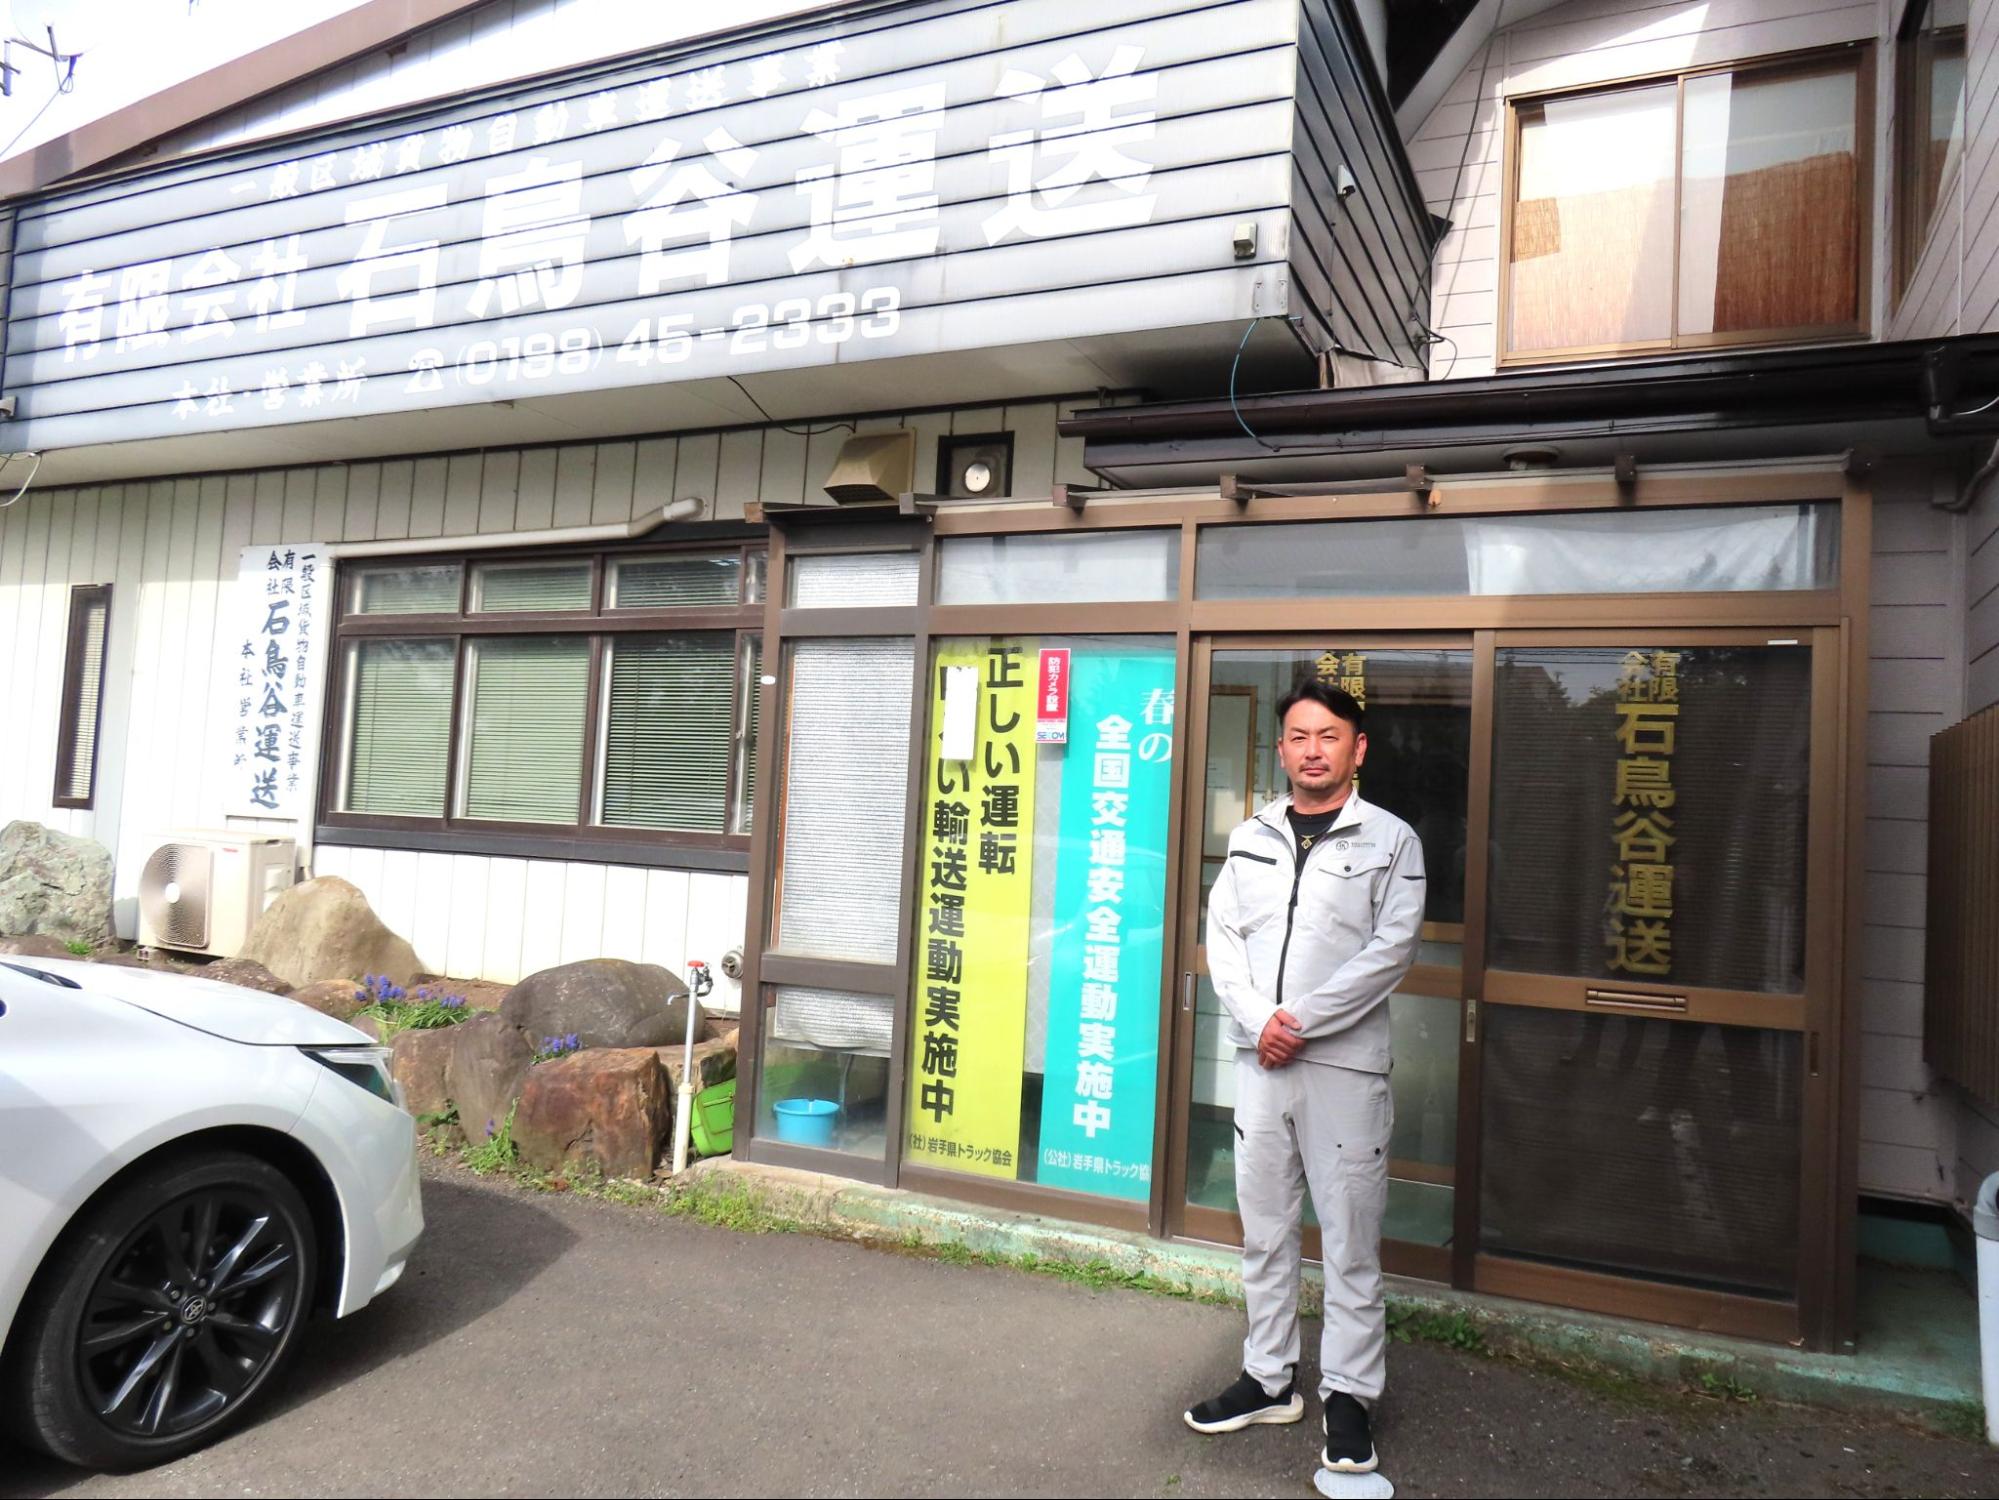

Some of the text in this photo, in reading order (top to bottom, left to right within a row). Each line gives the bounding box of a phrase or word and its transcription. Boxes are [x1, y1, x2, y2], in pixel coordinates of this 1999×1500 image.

[57, 44, 1160, 364] 有限会社 石鳥谷運送
[250, 600, 290, 810] 石鳥谷運送
[977, 647, 1023, 875] 正しい運転
[1138, 688, 1175, 763] 春の
[1604, 704, 1680, 975] 石鳥谷運送
[920, 666, 971, 1123] い輸送運動実施中
[1073, 714, 1133, 1138] 全国交通安全運動実施中
